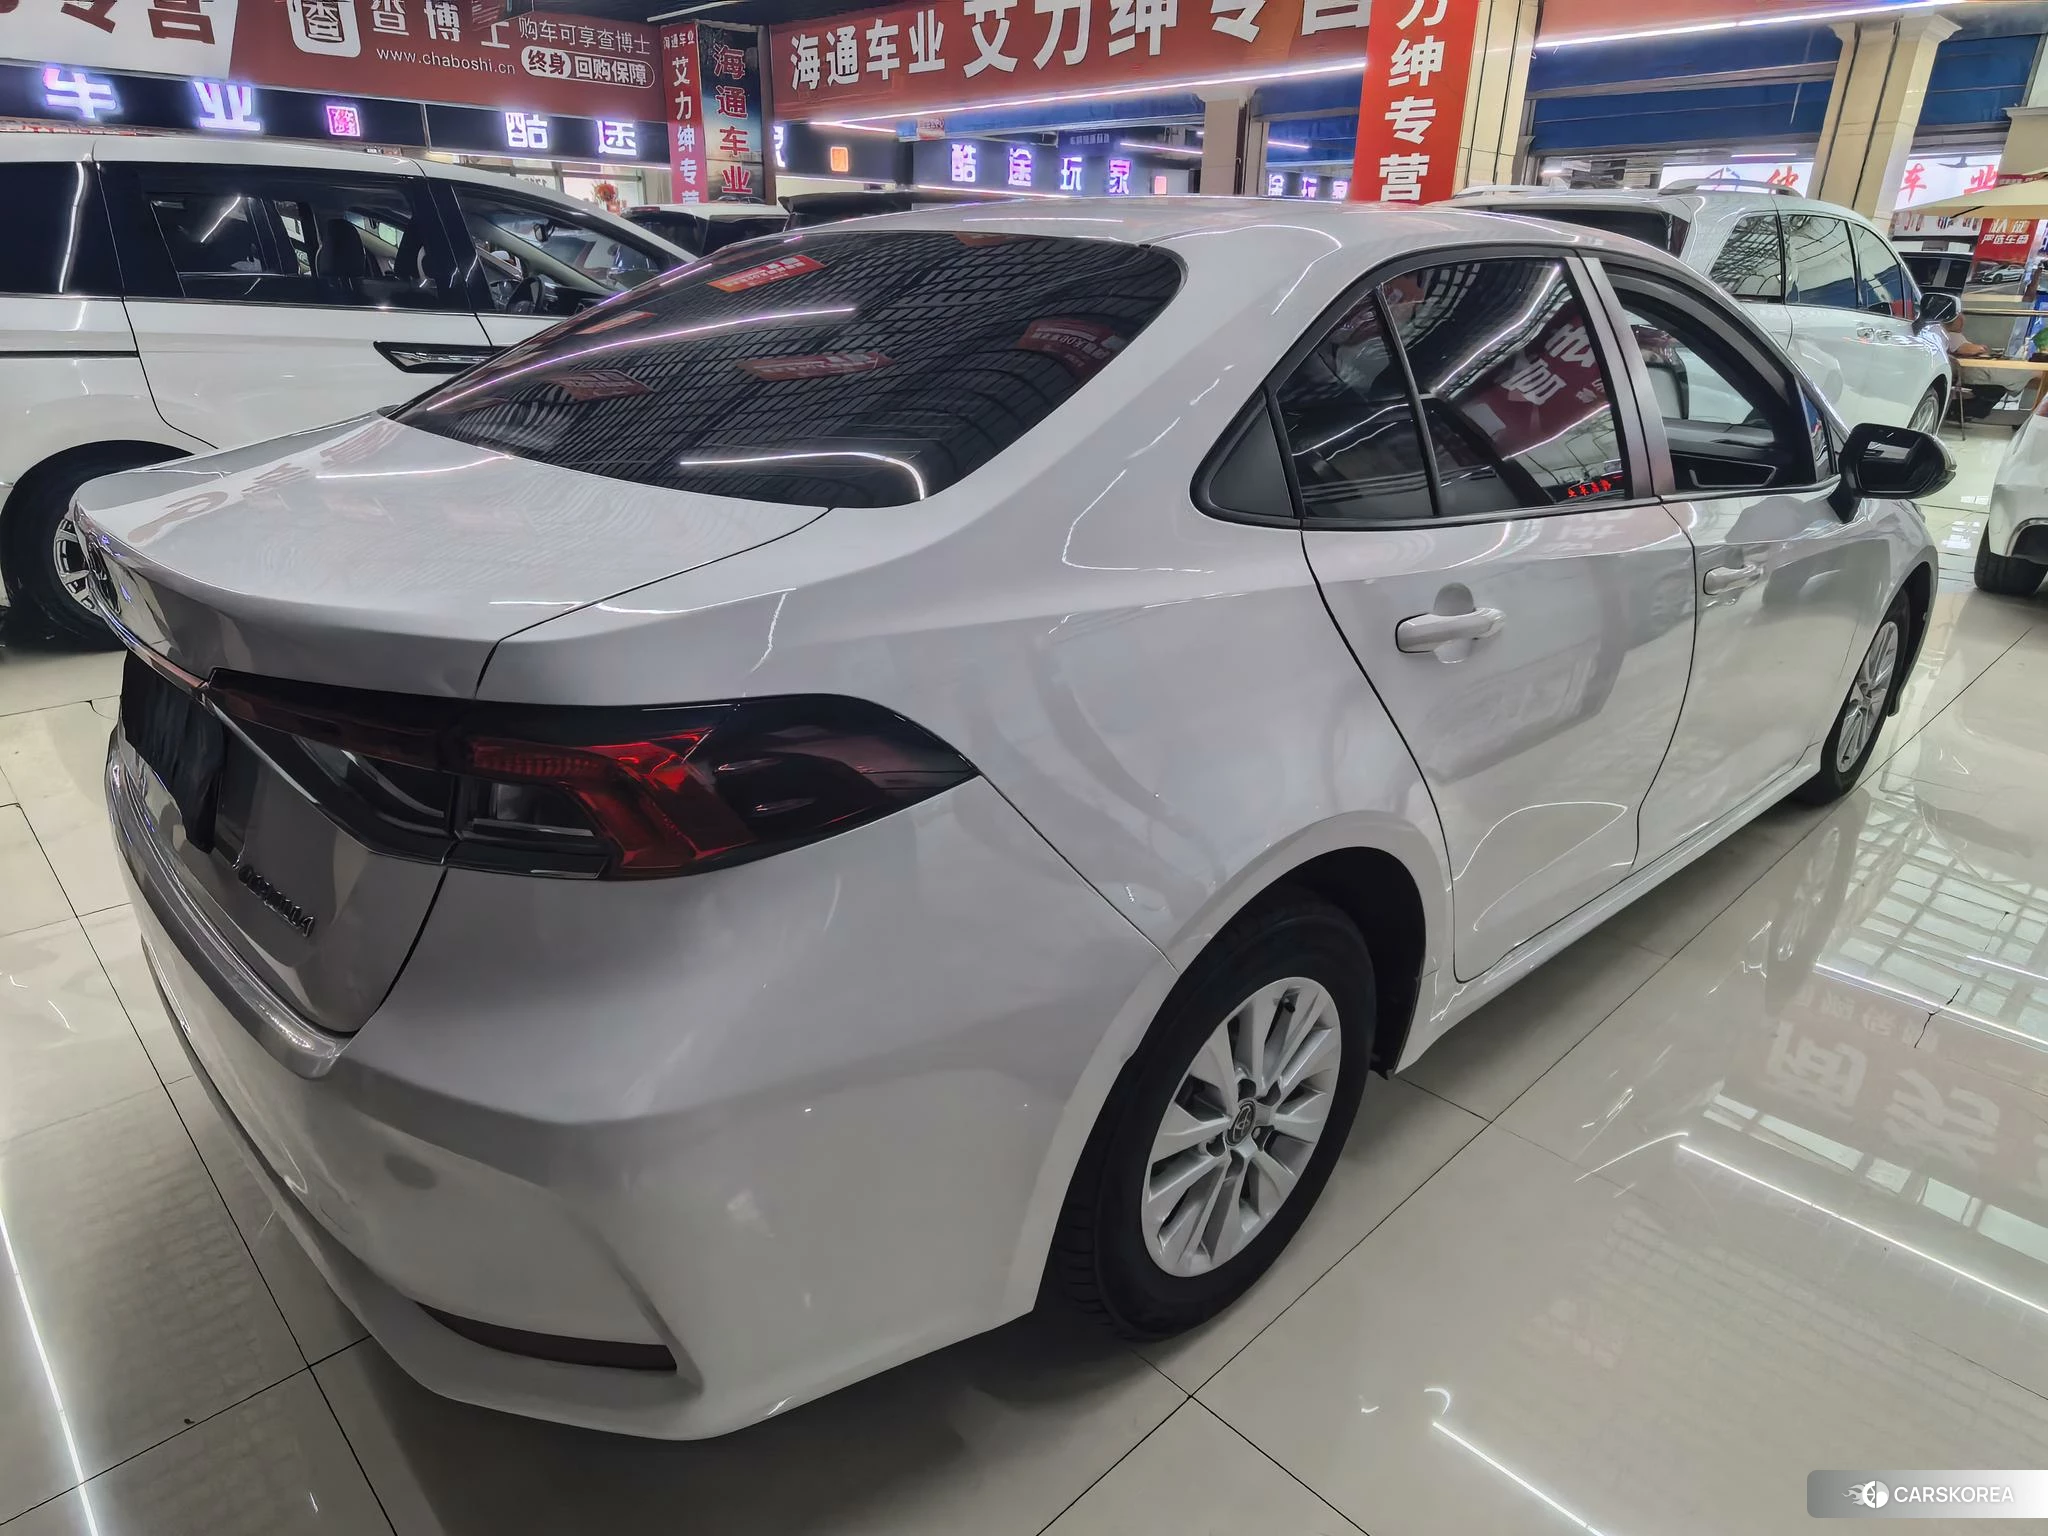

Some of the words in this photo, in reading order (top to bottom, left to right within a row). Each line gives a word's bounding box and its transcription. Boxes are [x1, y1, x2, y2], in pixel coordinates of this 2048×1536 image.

[518, 17, 651, 55] 购车可享查博士
[791, 9, 946, 91] 海通车业
[376, 48, 516, 75] www.chaboshi.cn
[527, 49, 566, 76] 终身
[574, 56, 647, 86] 回购保障
[713, 43, 752, 194] 海通车业
[951, 143, 1132, 195] 酷途玩家
